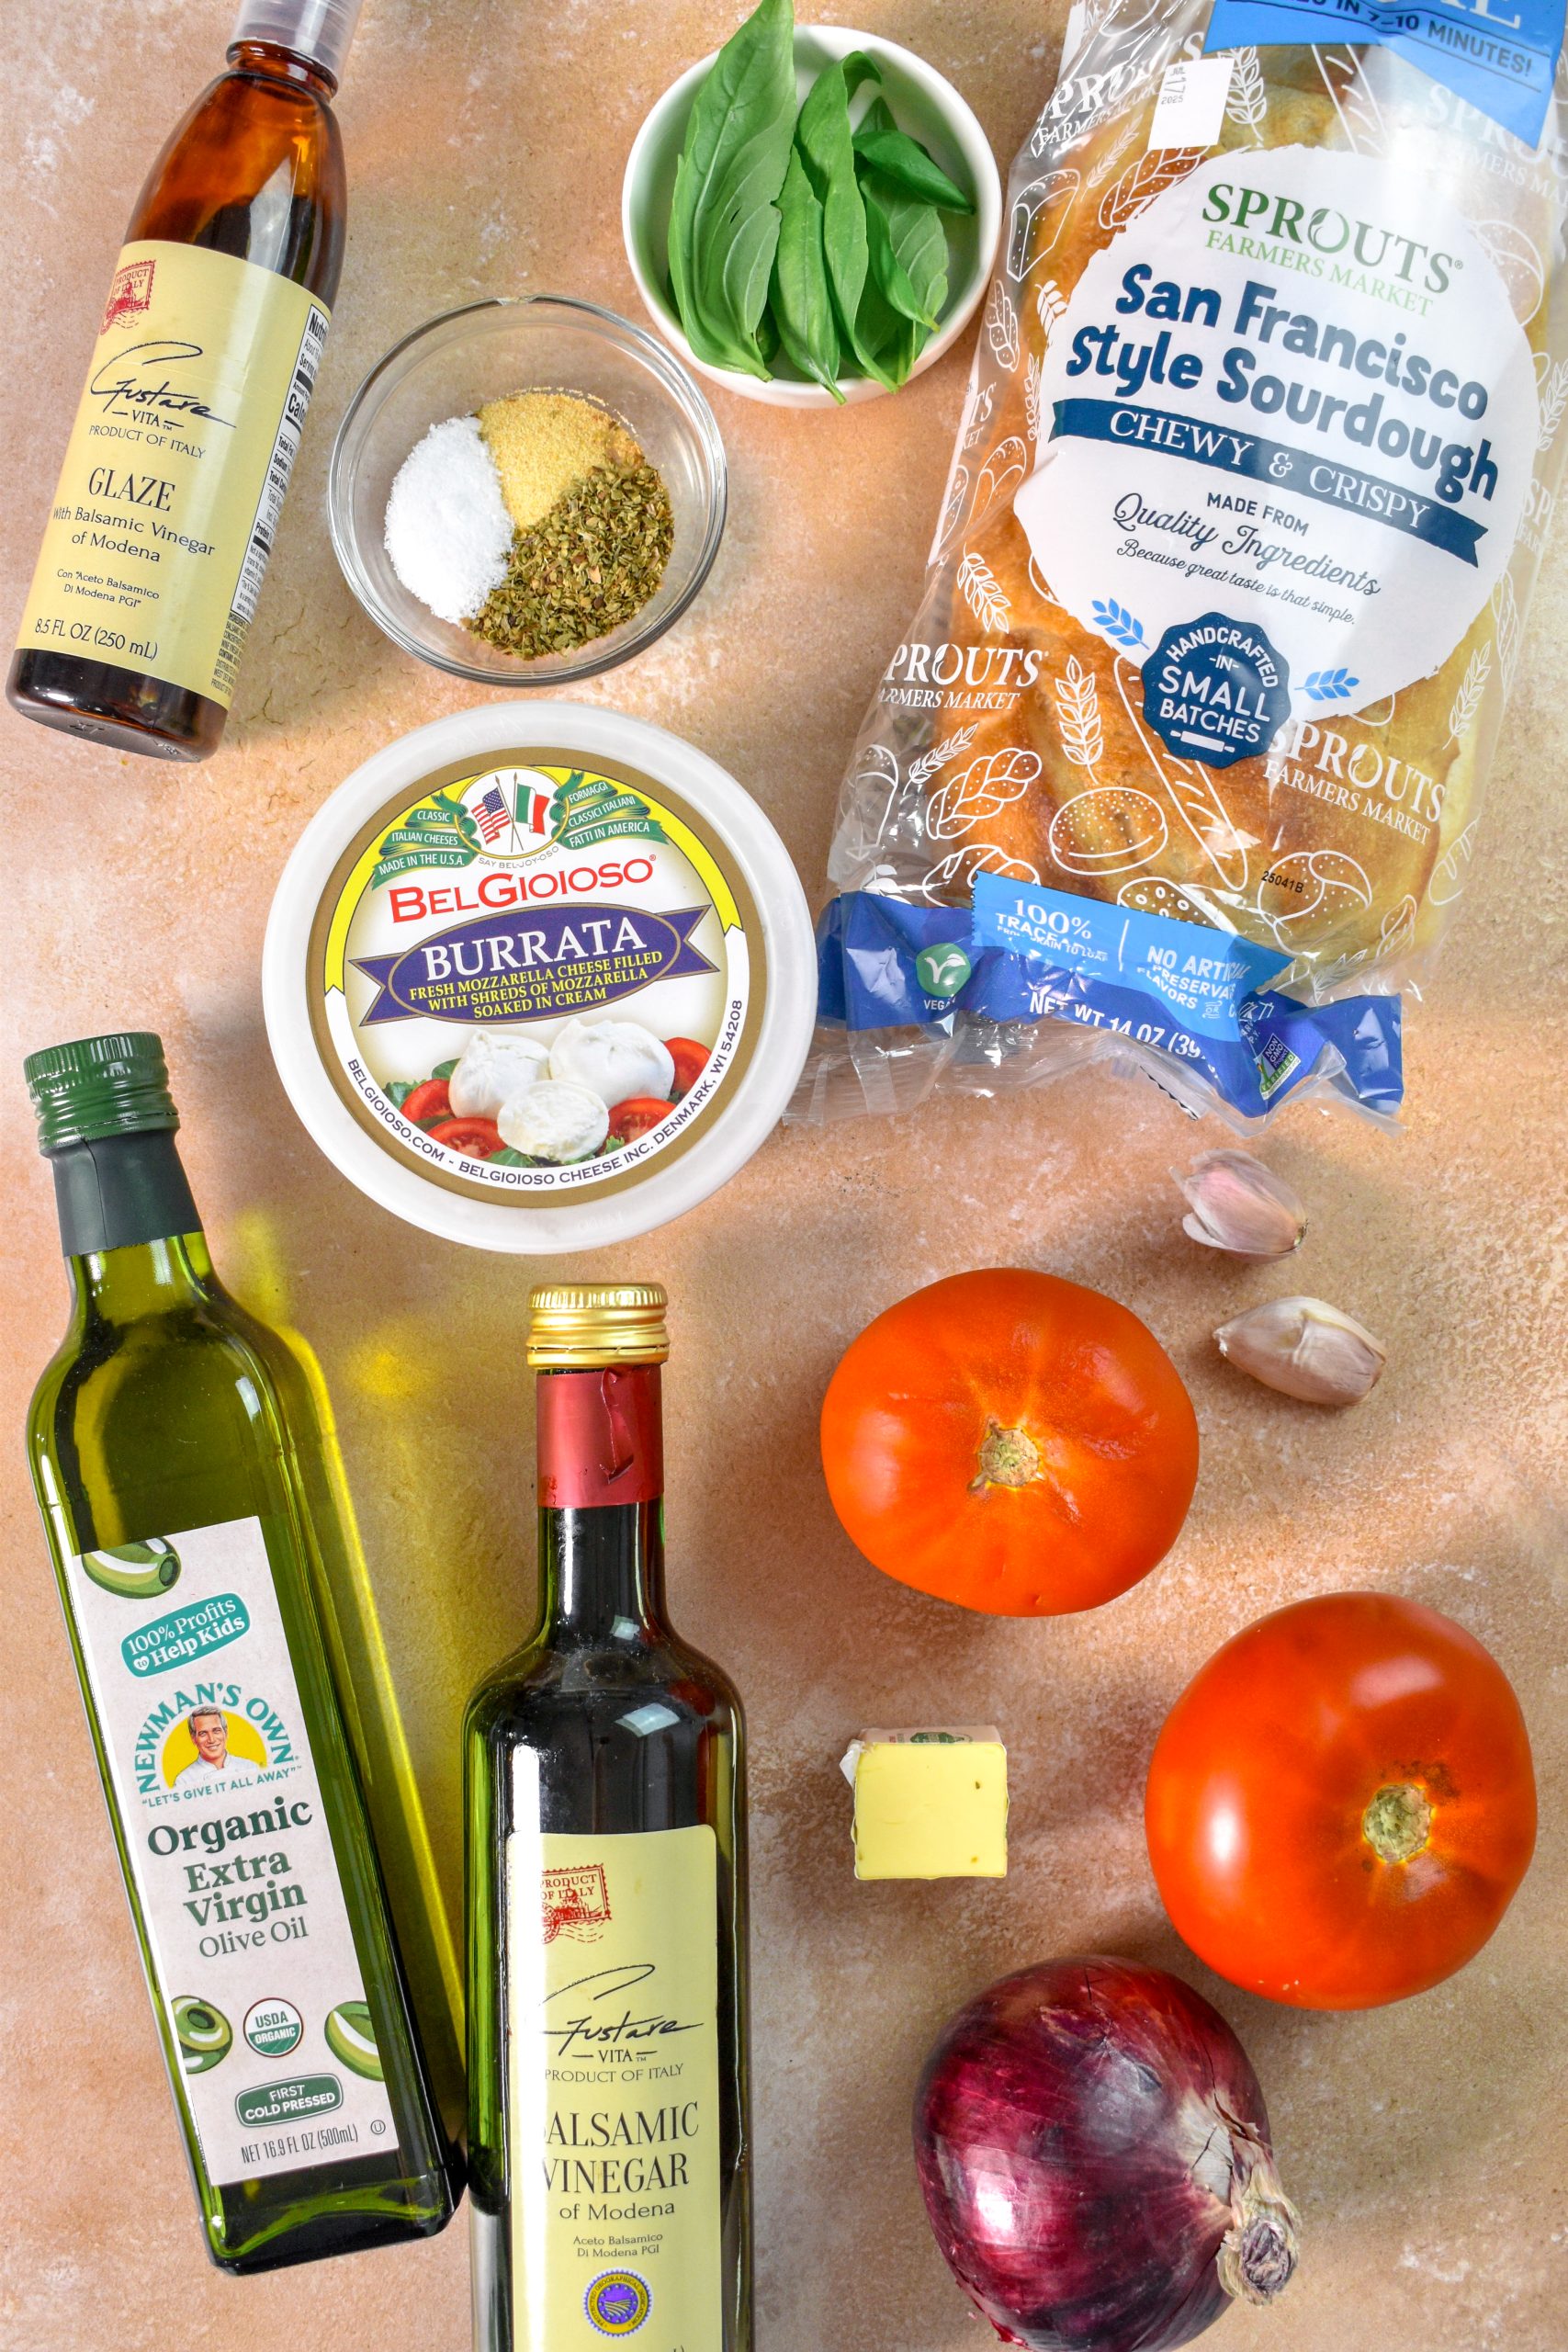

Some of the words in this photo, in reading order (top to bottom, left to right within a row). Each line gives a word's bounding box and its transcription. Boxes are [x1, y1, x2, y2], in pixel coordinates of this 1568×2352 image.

[1427, 19, 1533, 77] MINUTES!
[1161, 95, 1183, 105] 2025
[1202, 184, 1453, 294] SPROUTS
[1205, 230, 1324, 279] FARMERS
[1328, 266, 1434, 318] MARKET
[1116, 264, 1222, 328] San
[1234, 280, 1488, 421] Francisco
[131, 410, 161, 427] VITA
[1066, 324, 1203, 397] Style
[1216, 347, 1497, 504] Sourdough
[89, 425, 142, 447] PRODUCT
[146, 435, 167, 447] OF
[171, 439, 207, 458] ITALY
[88, 468, 175, 512] GLAZE
[1110, 410, 1255, 466] CHEWY
[1269, 452, 1293, 479] &
[1309, 465, 1431, 529] CRISPY
[74, 506, 145, 533] Balsamic
[152, 521, 216, 557] Vinegar
[1206, 492, 1257, 516] MADE
[1263, 505, 1311, 537] FROM
[72, 531, 87, 545] of
[90, 533, 161, 562] Modena
[1113, 492, 1219, 551] Quality
[1222, 525, 1382, 596] Ingredients
[57, 568, 73, 579] Con
[107, 577, 160, 600] Balsamico
[75, 586, 116, 602] Modena
[1116, 538, 1188, 571] Because
[1185, 560, 1230, 582] great
[1229, 571, 1267, 593] taste
[1265, 583, 1282, 598] is
[1280, 588, 1311, 608] that
[1313, 599, 1356, 625] simple.
[34, 617, 50, 634] 8.5
[51, 619, 66, 637] FL
[70, 622, 92, 641] OZ
[94, 626, 126, 650] (250
[130, 641, 159, 661] mL)
[1166, 627, 1278, 688] HANDCRAFTED
[883, 643, 1043, 687] PROUTS
[878, 687, 943, 708] ARMERS
[943, 691, 1021, 710] MARKET
[1158, 666, 1270, 722] SMALL
[1160, 698, 1260, 743] BATCHES
[568, 782, 608, 804] FORMAGGI
[568, 807, 604, 828] CLASSICI
[603, 796, 636, 816] ITALIANI
[1263, 758, 1360, 812] FARMERS
[1361, 797, 1431, 845] MARKET
[417, 810, 451, 822] CLASSIC
[569, 831, 595, 848] FATTI
[594, 828, 605, 839] IN
[607, 821, 650, 836] AMERICA
[391, 831, 423, 842] ITALIAN
[423, 833, 458, 846] CHEESES
[478, 857, 497, 867] SAY
[499, 845, 559, 869] BEL-JOY-OSO
[378, 858, 406, 876] MADE
[407, 855, 418, 866] IN
[420, 854, 438, 865] THE
[440, 854, 465, 865] U.S.A.
[1261, 870, 1304, 893] 25041B
[1013, 899, 1092, 940] 100%
[420, 917, 648, 981] BURRATA
[1147, 945, 1177, 969] NO
[409, 982, 455, 1001] FRESH
[457, 967, 555, 994] MOZZARELLA
[557, 957, 613, 978] CHEESE
[614, 951, 663, 969] FILLED
[428, 995, 468, 1012] WITH
[471, 984, 526, 1005] SHREDS
[530, 980, 548, 996] OF
[551, 967, 649, 993] MOZZARELLA
[1136, 967, 1199, 1010] FLAVORS
[474, 1000, 533, 1020] SOAKED
[536, 996, 552, 1010] IN
[555, 987, 607, 1007] CREAM
[1030, 994, 1068, 1014] NET
[1076, 1003, 1105, 1027] WT
[1136, 1022, 1166, 1046] OZ
[347, 1058, 446, 1162] BELGIOIOSO.COM
[458, 1160, 555, 1185] BELGIOIOSO
[559, 1157, 623, 1183] CHEESE
[624, 1143, 654, 1163] INC.
[652, 1080, 716, 1146] DENMARK,
[710, 1055, 728, 1076] WI
[720, 1000, 742, 1053] 54208
[127, 1623, 175, 1656] 100%
[175, 1600, 236, 1635] Profits
[150, 1637, 198, 1667] Help
[196, 1616, 246, 1646] Kids
[245, 1697, 295, 1766] OWN
[183, 1784, 213, 1801] GIVE
[215, 1781, 228, 1793] IT
[230, 1776, 254, 1791] ALL
[147, 1795, 313, 1857] Organic
[183, 1849, 292, 1894] Extra
[183, 1879, 308, 1928] Virgin
[198, 1925, 266, 1959] Olive
[270, 1916, 310, 1943] Oil
[254, 2009, 289, 2029] USDA
[254, 2026, 296, 2045] ORGANIC
[545, 2068, 616, 2083] PRODUCT
[622, 2068, 643, 2082] OF
[649, 2063, 684, 2079] ITALY
[598, 2049, 634, 2064] VITA
[244, 2104, 281, 2121] COLD
[283, 2091, 336, 2112] PRESSED
[268, 2084, 306, 2102] FIRST
[241, 2144, 261, 2165] NET
[263, 2137, 286, 2160] 16.9
[288, 2133, 301, 2154] FL
[301, 2132, 316, 2151] OZ
[317, 2123, 359, 2150] (500mL)
[544, 2101, 700, 2147] ALSAMIC
[542, 2153, 690, 2195] VINEGAR
[559, 2203, 581, 2220] of
[588, 2201, 676, 2221] Modena
[573, 2234, 604, 2246] Aceto
[608, 2233, 663, 2245] Balsamico
[592, 2247, 638, 2257] Modena
[641, 2245, 660, 2256] PGI
